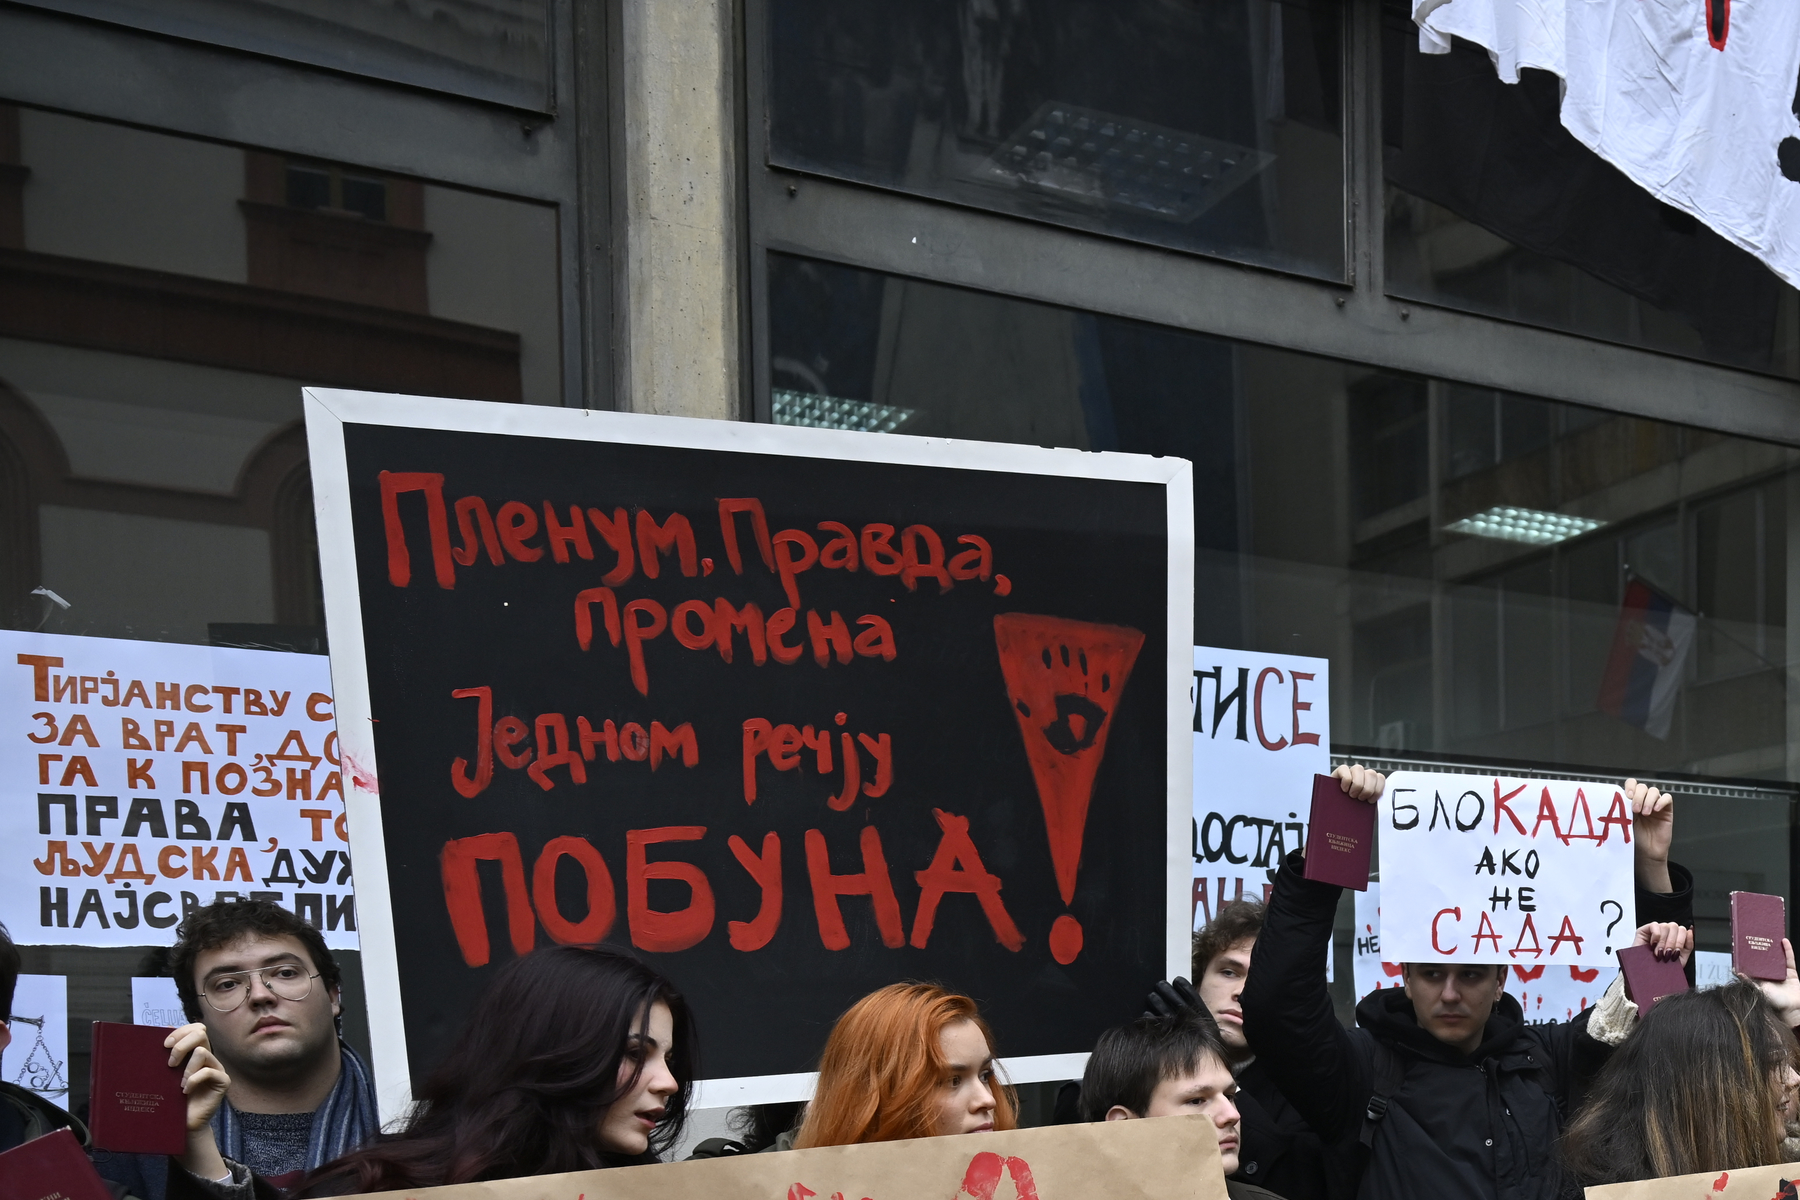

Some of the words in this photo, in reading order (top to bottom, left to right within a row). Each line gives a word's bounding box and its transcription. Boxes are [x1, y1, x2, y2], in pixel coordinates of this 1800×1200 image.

[27, 711, 101, 749] ЗА
[451, 685, 700, 798] Једном
[741, 711, 893, 811] речју
[38, 753, 99, 787] ГА
[126, 757, 156, 790] К
[37, 793, 279, 853] ПРАВА,
[1391, 778, 1632, 847] БЛОКАДА
[33, 840, 255, 885] ЉУДСКА
[1475, 846, 1540, 880] АКО
[1488, 886, 1537, 912] НЕ
[116, 1091, 164, 1100] СТУДЕНТСКА
